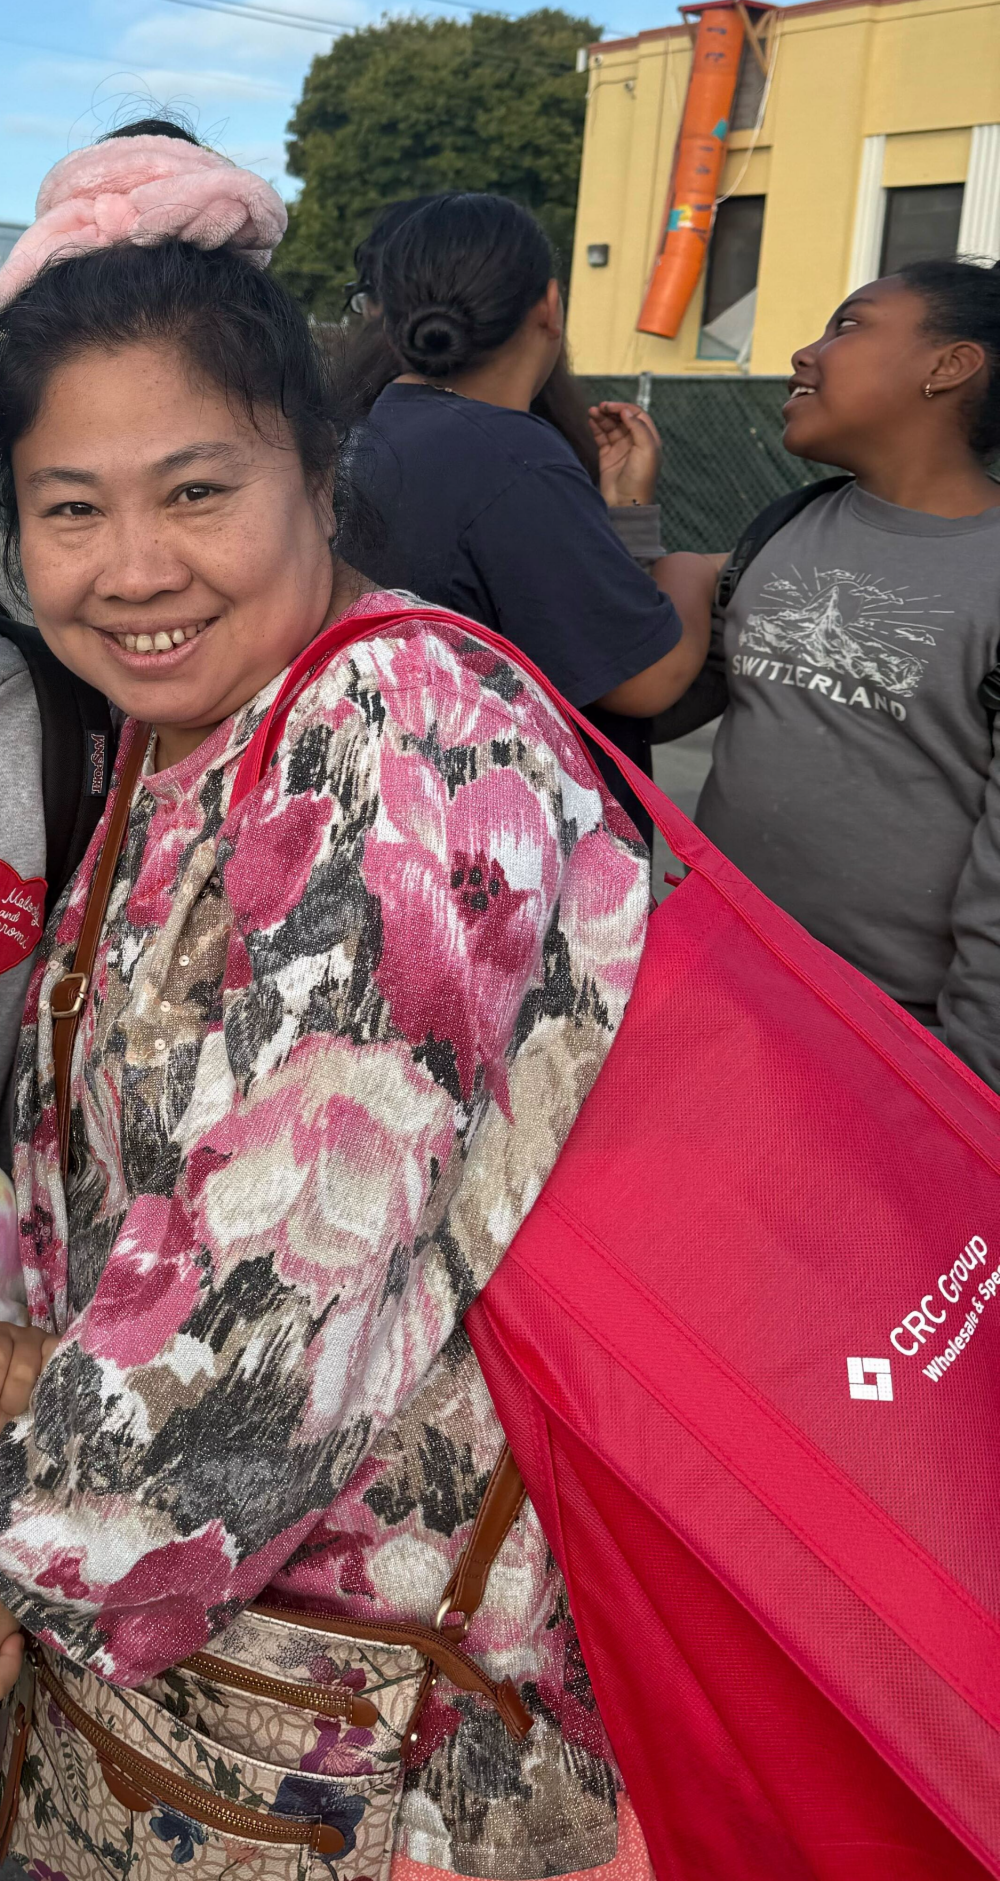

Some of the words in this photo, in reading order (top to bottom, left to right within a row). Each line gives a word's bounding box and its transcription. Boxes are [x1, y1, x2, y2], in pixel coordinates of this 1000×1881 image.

[732, 655, 907, 722] SWITZERLAND
[0, 909, 20, 922] and
[2, 887, 40, 928] Melody
[890, 1295, 946, 1356] CRC
[938, 1235, 988, 1303] Group
[922, 1310, 979, 1383] Wholesale
[972, 1296, 985, 1314] &
